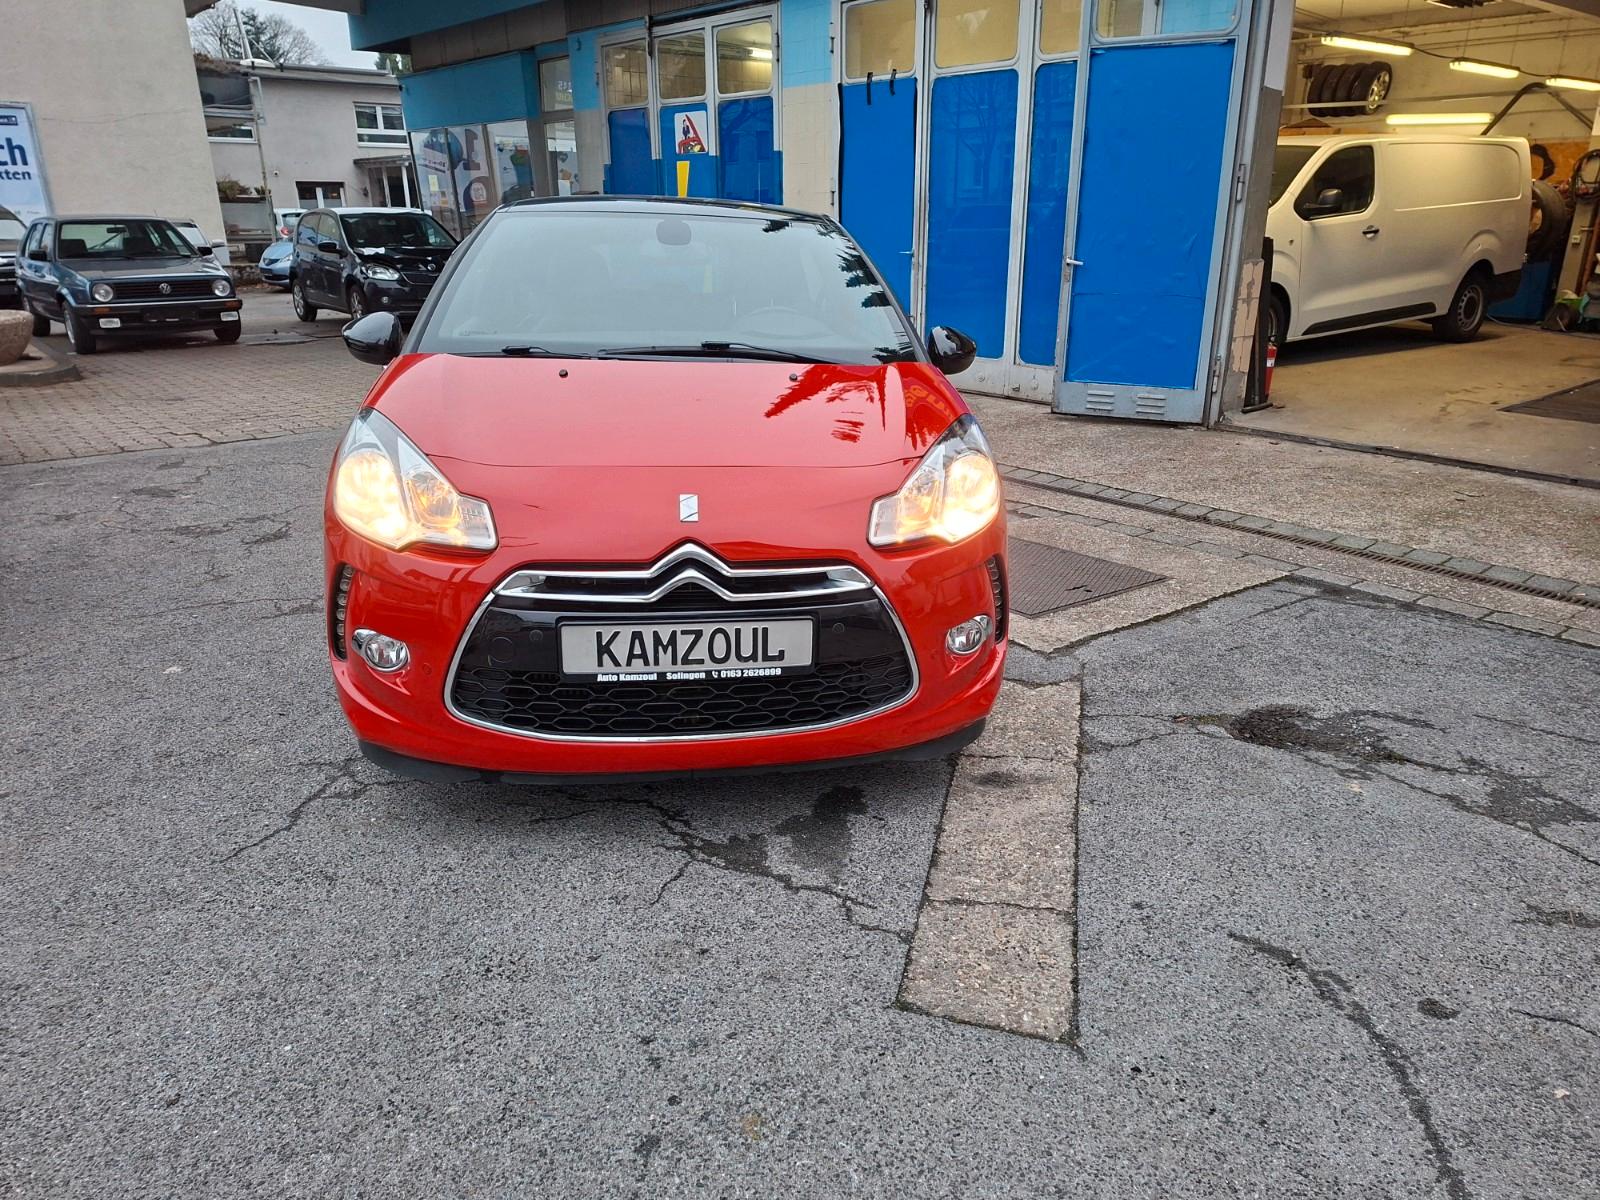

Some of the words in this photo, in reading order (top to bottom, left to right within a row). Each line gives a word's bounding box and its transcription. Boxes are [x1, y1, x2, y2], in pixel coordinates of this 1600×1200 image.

[595, 626, 786, 668] KAMZOUL
[597, 673, 618, 682] Auto
[619, 672, 658, 681] Kamzoul
[666, 671, 706, 680] Solingen
[720, 669, 742, 678] 0163
[743, 667, 782, 677] 2626899
